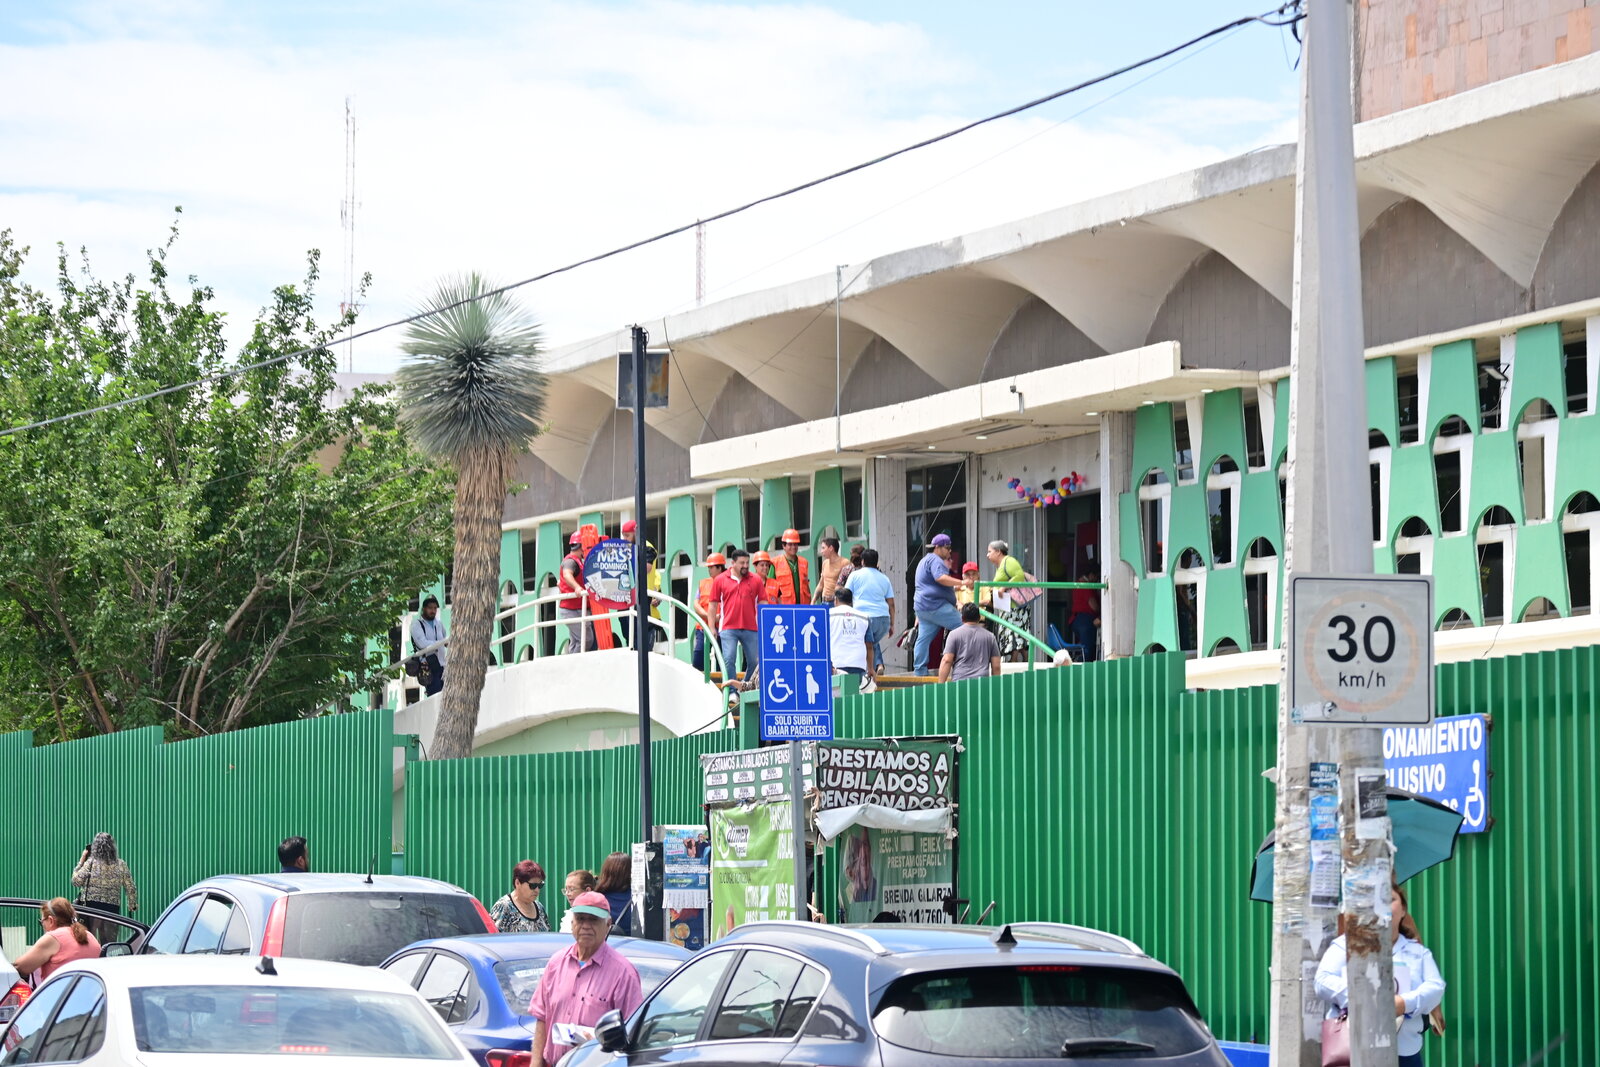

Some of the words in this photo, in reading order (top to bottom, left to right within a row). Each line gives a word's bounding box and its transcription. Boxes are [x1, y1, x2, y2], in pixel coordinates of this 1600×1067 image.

[600, 562, 628, 570] DOMINGO
[1327, 615, 1396, 663] 30
[1338, 670, 1386, 689] km/h
[774, 715, 792, 725] SOLO
[793, 715, 812, 725] SUBIR
[813, 715, 819, 724] Y
[768, 726, 789, 736] BAJAR
[790, 725, 827, 736] PACIENTES
[1382, 717, 1483, 759] ONAMIENTO
[711, 755, 735, 772] ESTAMOS
[736, 757, 740, 769] A
[741, 753, 769, 768] JUBILADOS
[769, 751, 774, 765] Y
[819, 747, 931, 772] PRESTAMOS
[934, 753, 949, 772] A
[820, 768, 930, 794] JUBILADOS
[934, 775, 949, 794] Y
[820, 790, 946, 811] PENSIONADOS
[884, 888, 914, 904] BRENDA
[892, 909, 906, 923] 66
